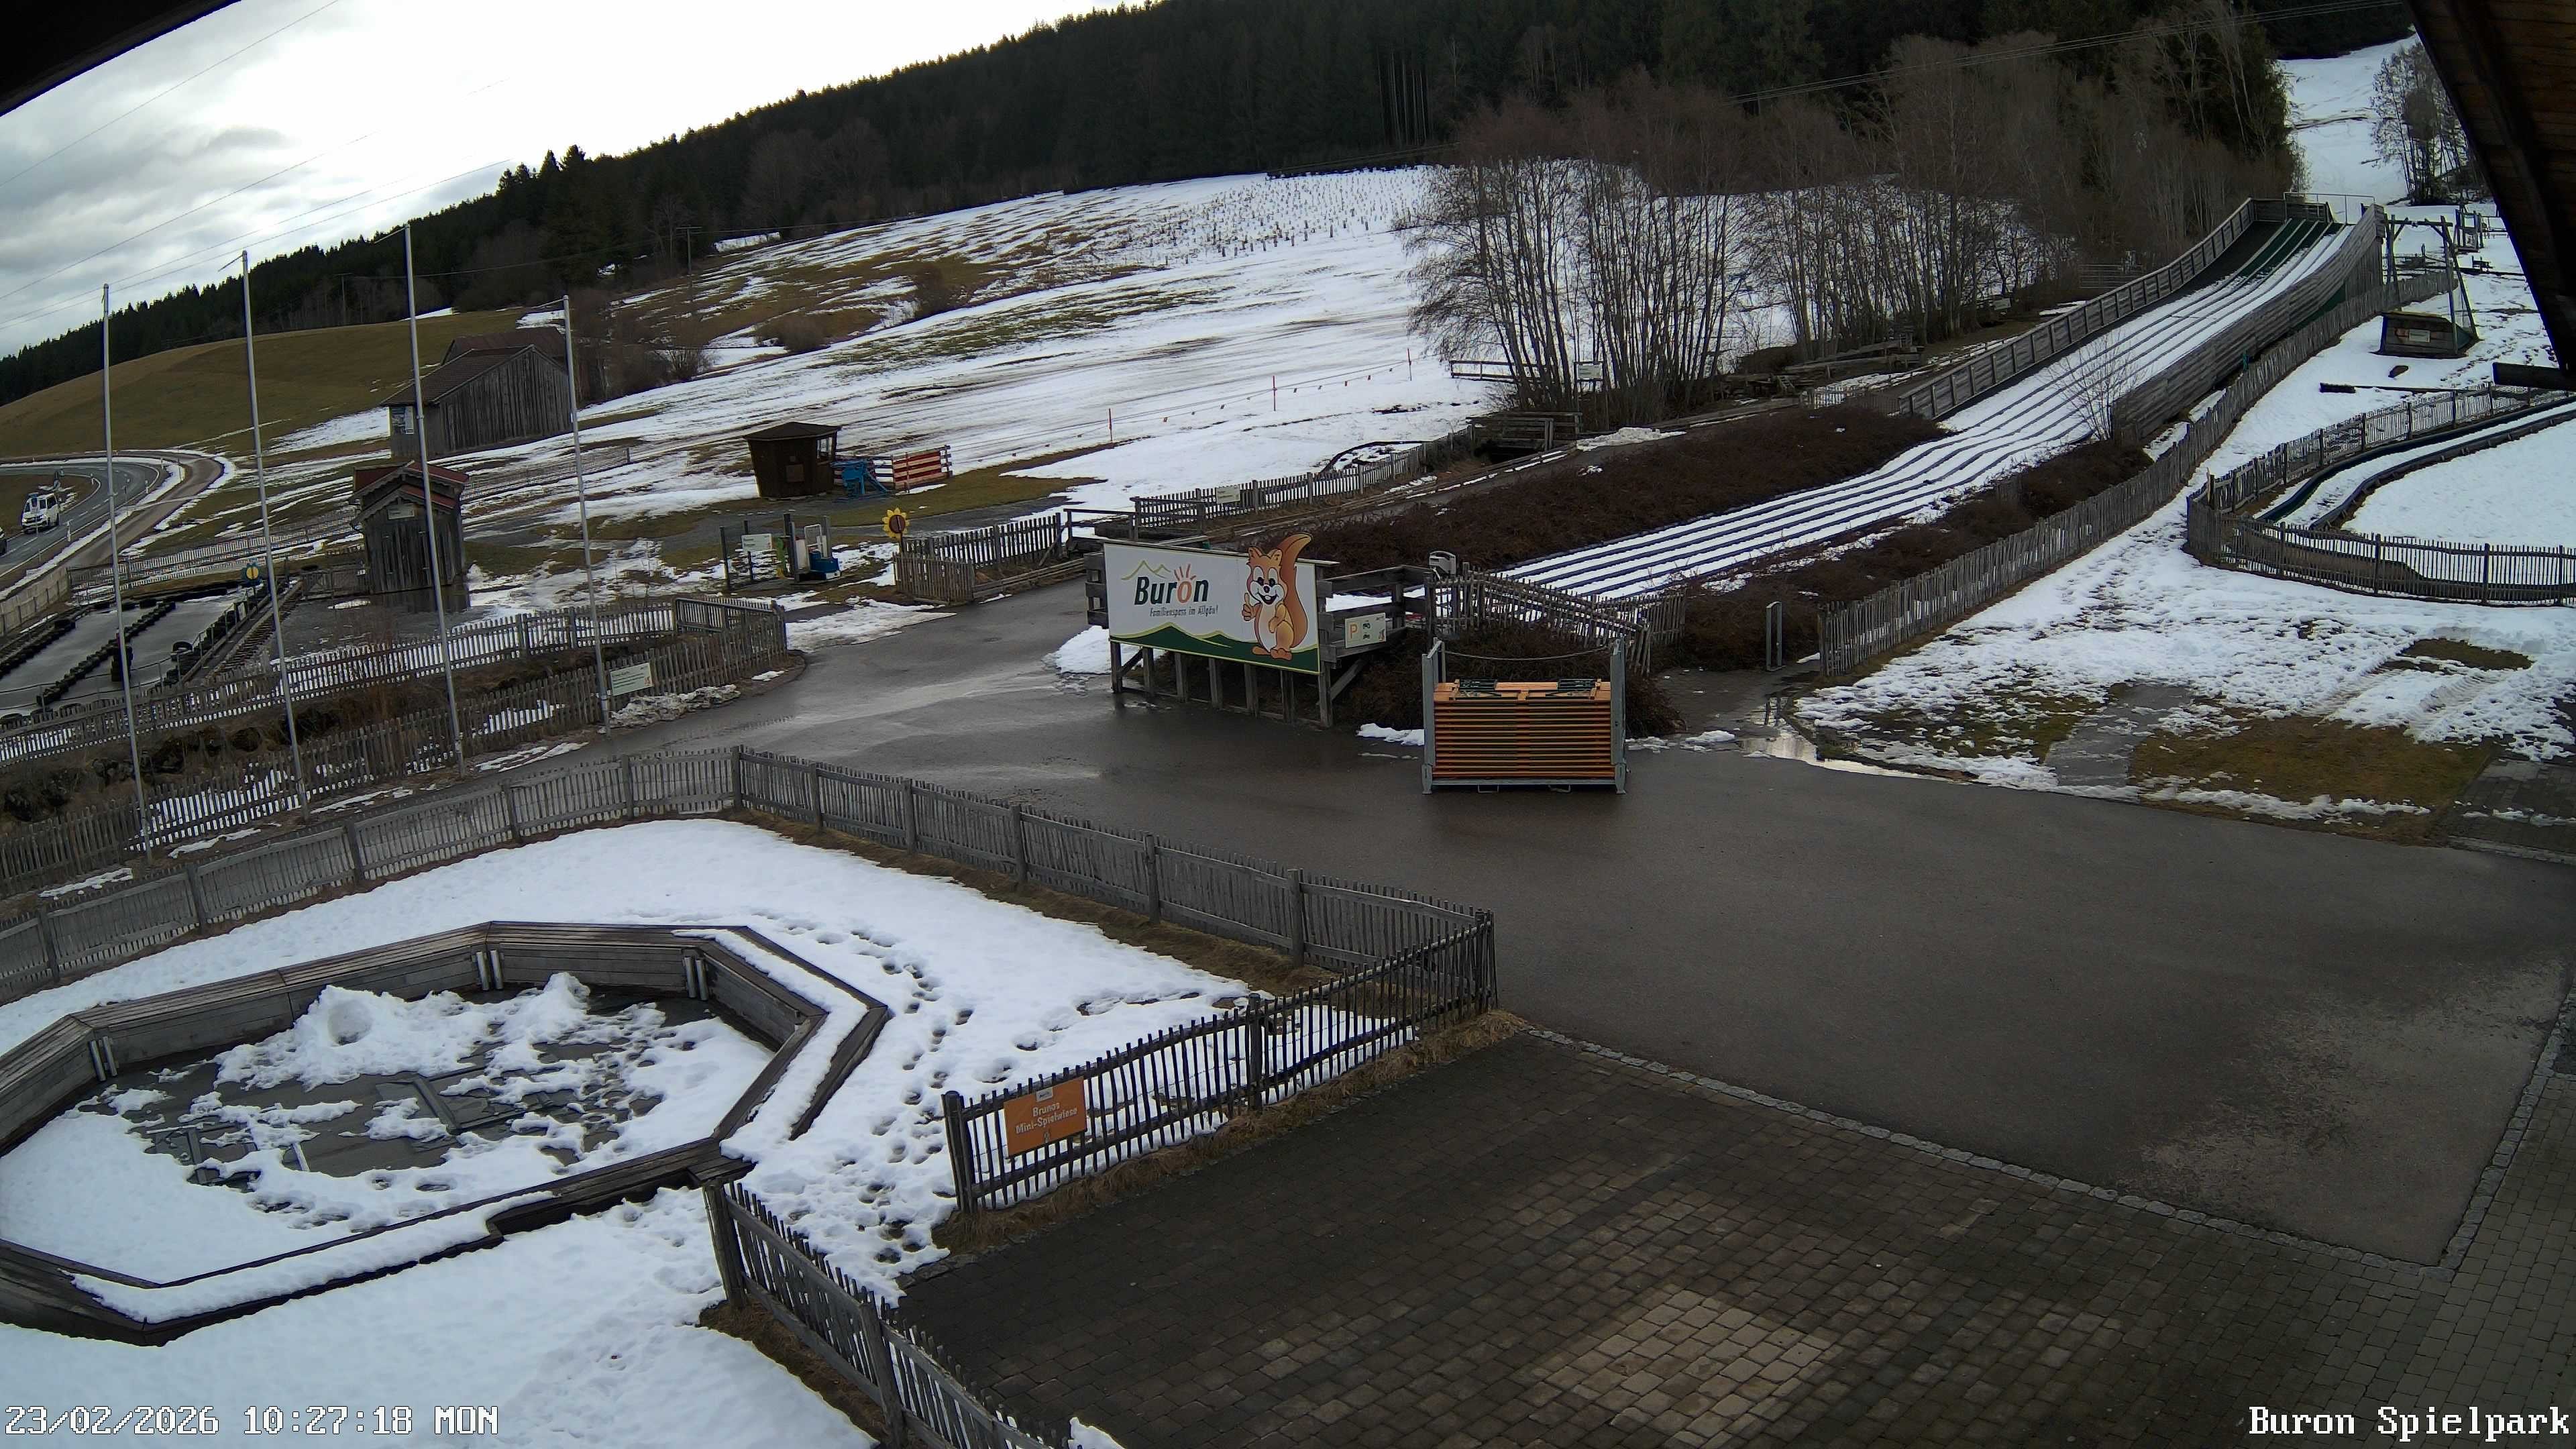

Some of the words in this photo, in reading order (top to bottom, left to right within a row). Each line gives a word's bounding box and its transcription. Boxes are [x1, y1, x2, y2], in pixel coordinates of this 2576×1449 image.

[1134, 576, 1210, 606] Buron
[1189, 606, 1195, 616] im
[1350, 623, 1358, 639] P
[1032, 1102, 1060, 1117] Brunos
